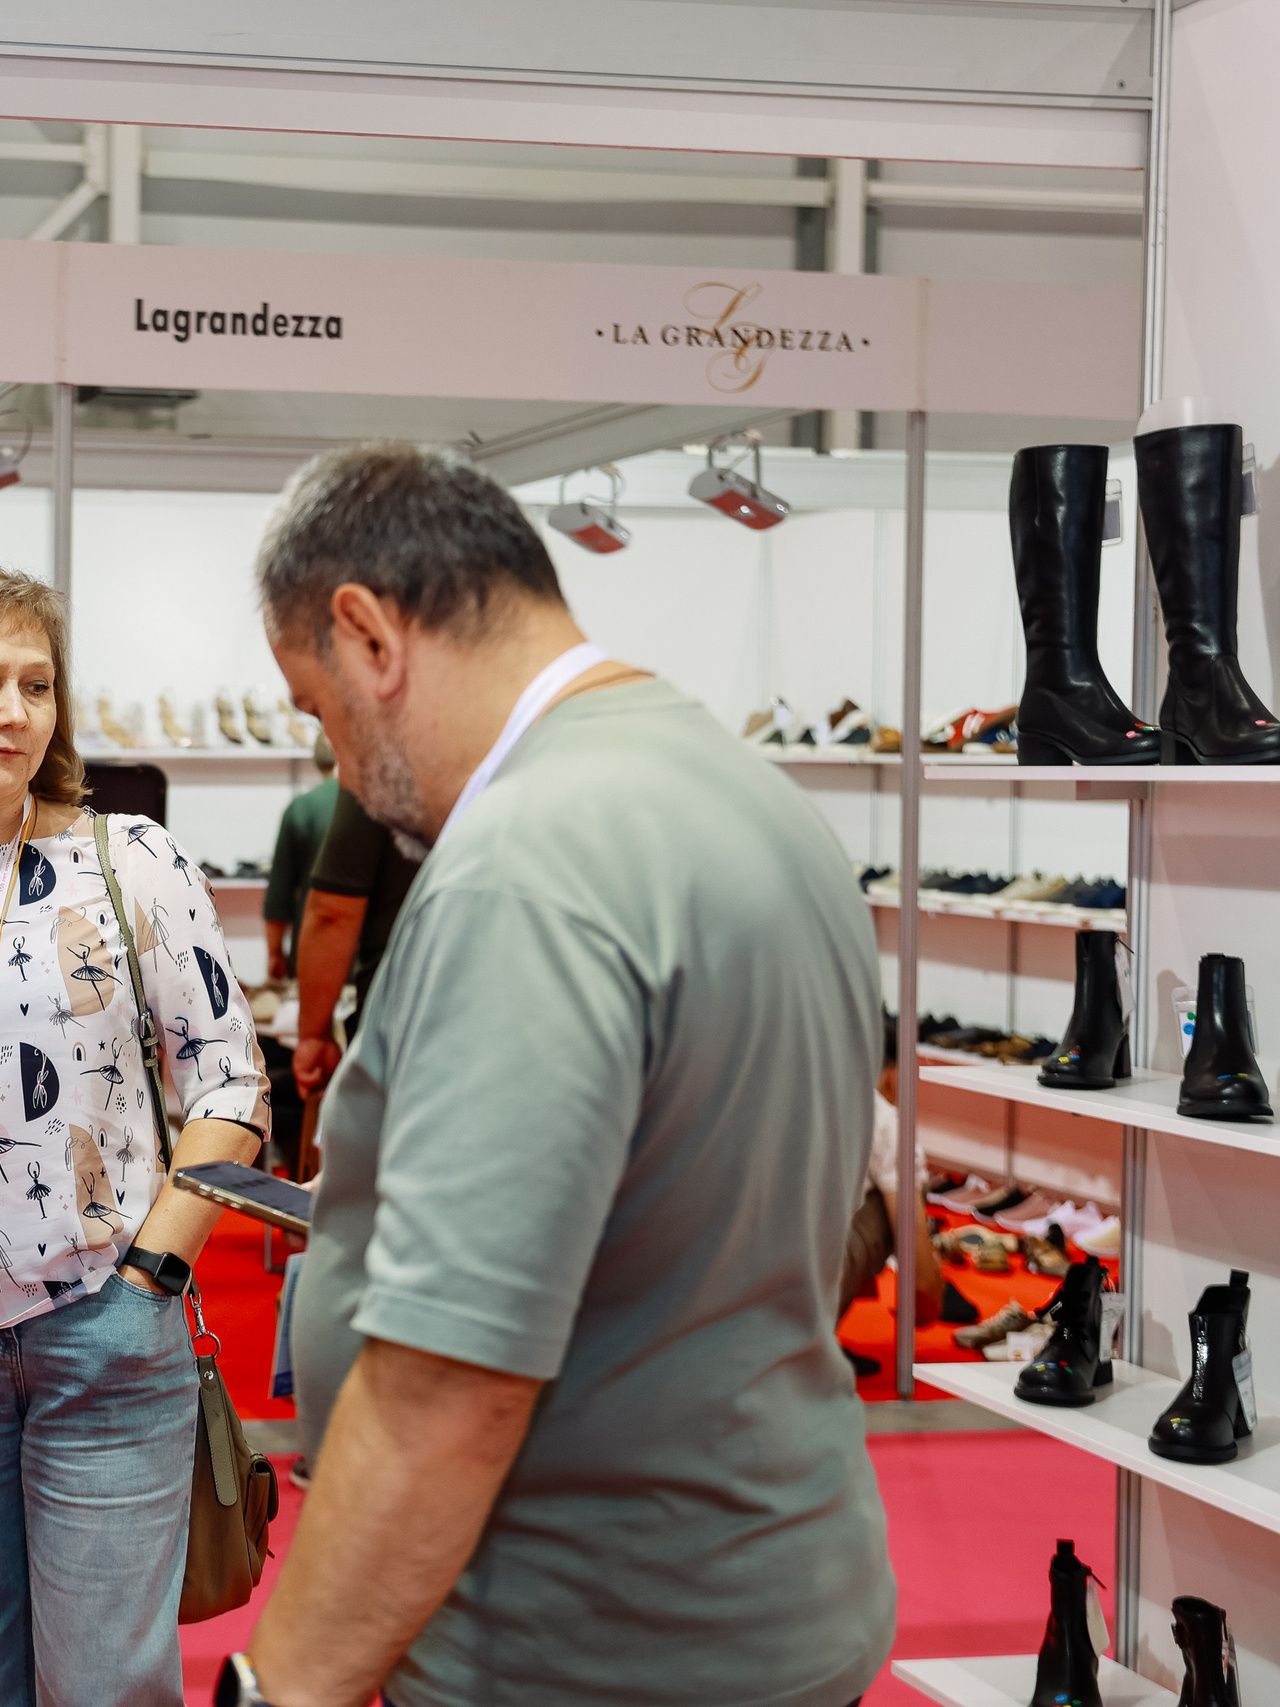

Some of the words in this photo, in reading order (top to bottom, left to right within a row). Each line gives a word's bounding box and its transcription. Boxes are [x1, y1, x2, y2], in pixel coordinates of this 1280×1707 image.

[135, 299, 343, 343] Lagrandezza
[612, 323, 650, 346] LA
[660, 325, 856, 352] GRANDEZZA
